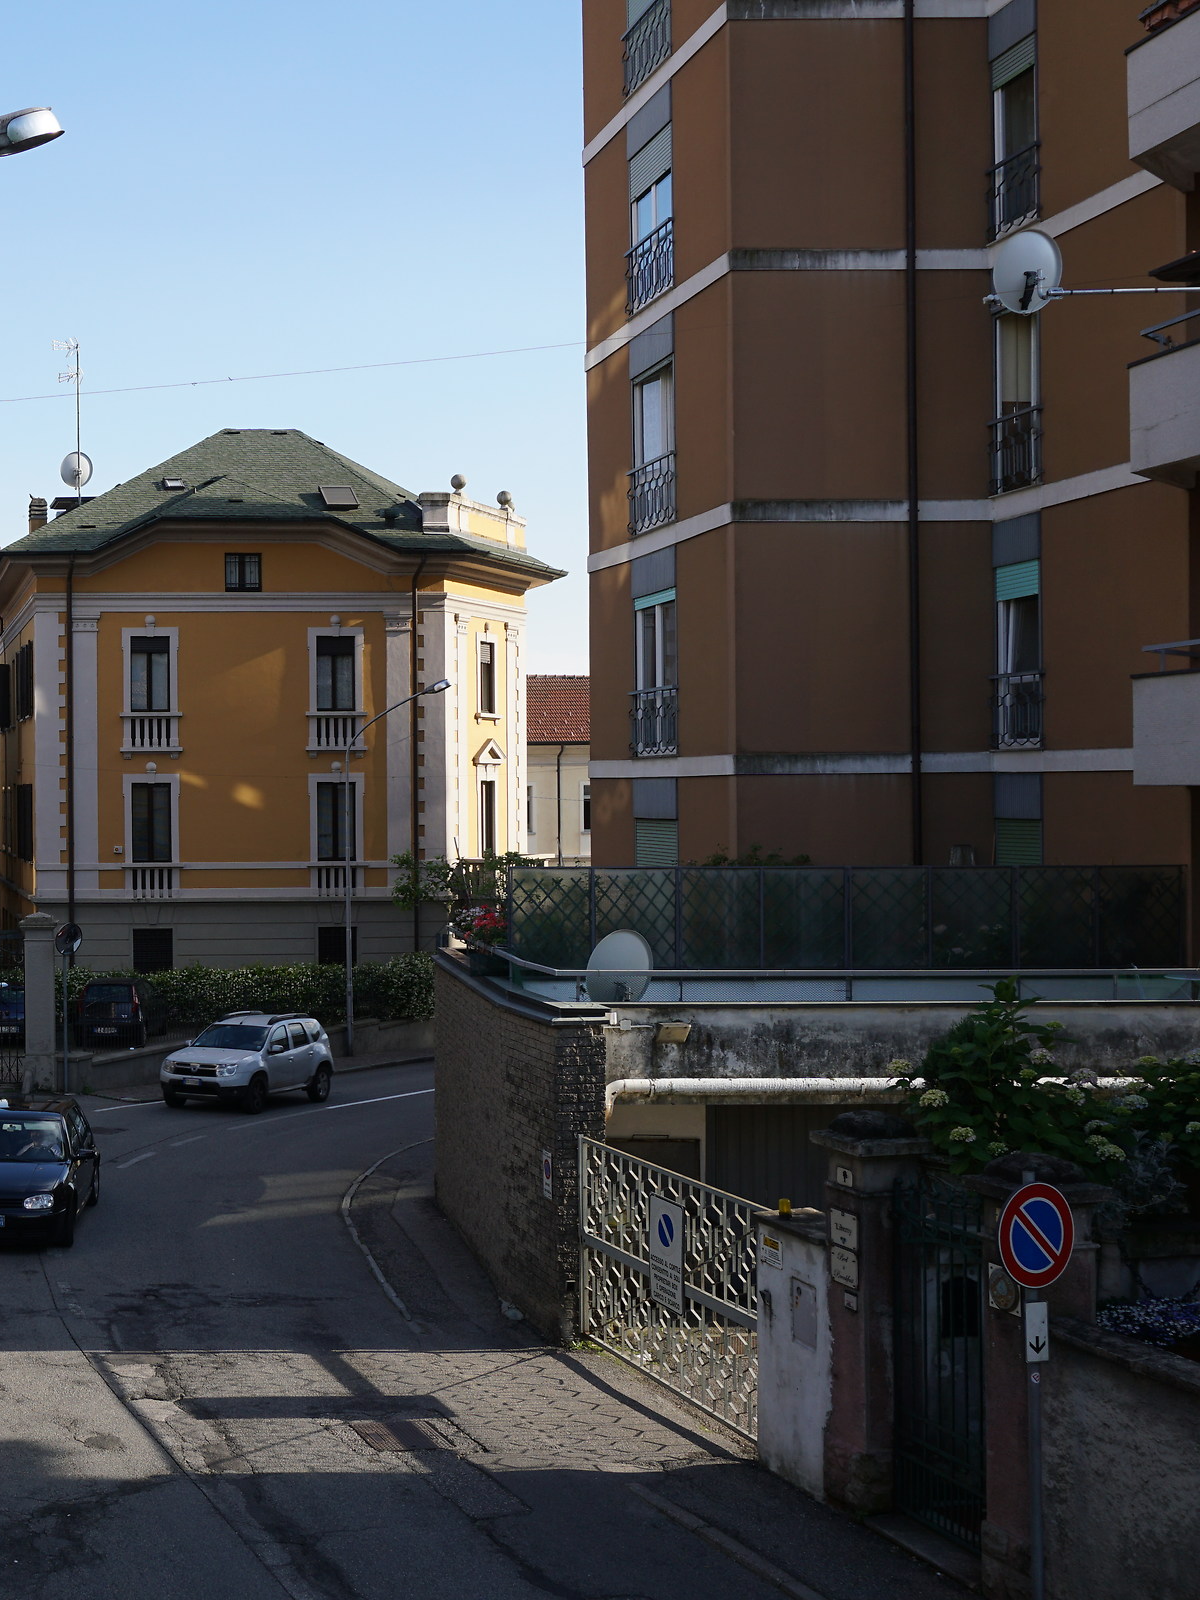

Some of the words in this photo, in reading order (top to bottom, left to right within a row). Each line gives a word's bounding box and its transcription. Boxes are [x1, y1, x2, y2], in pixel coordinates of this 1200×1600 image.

[650, 1254, 664, 1266] ACCESSO
[669, 1262, 681, 1275] CORTILE
[651, 1262, 669, 1278] CONSENTITO
